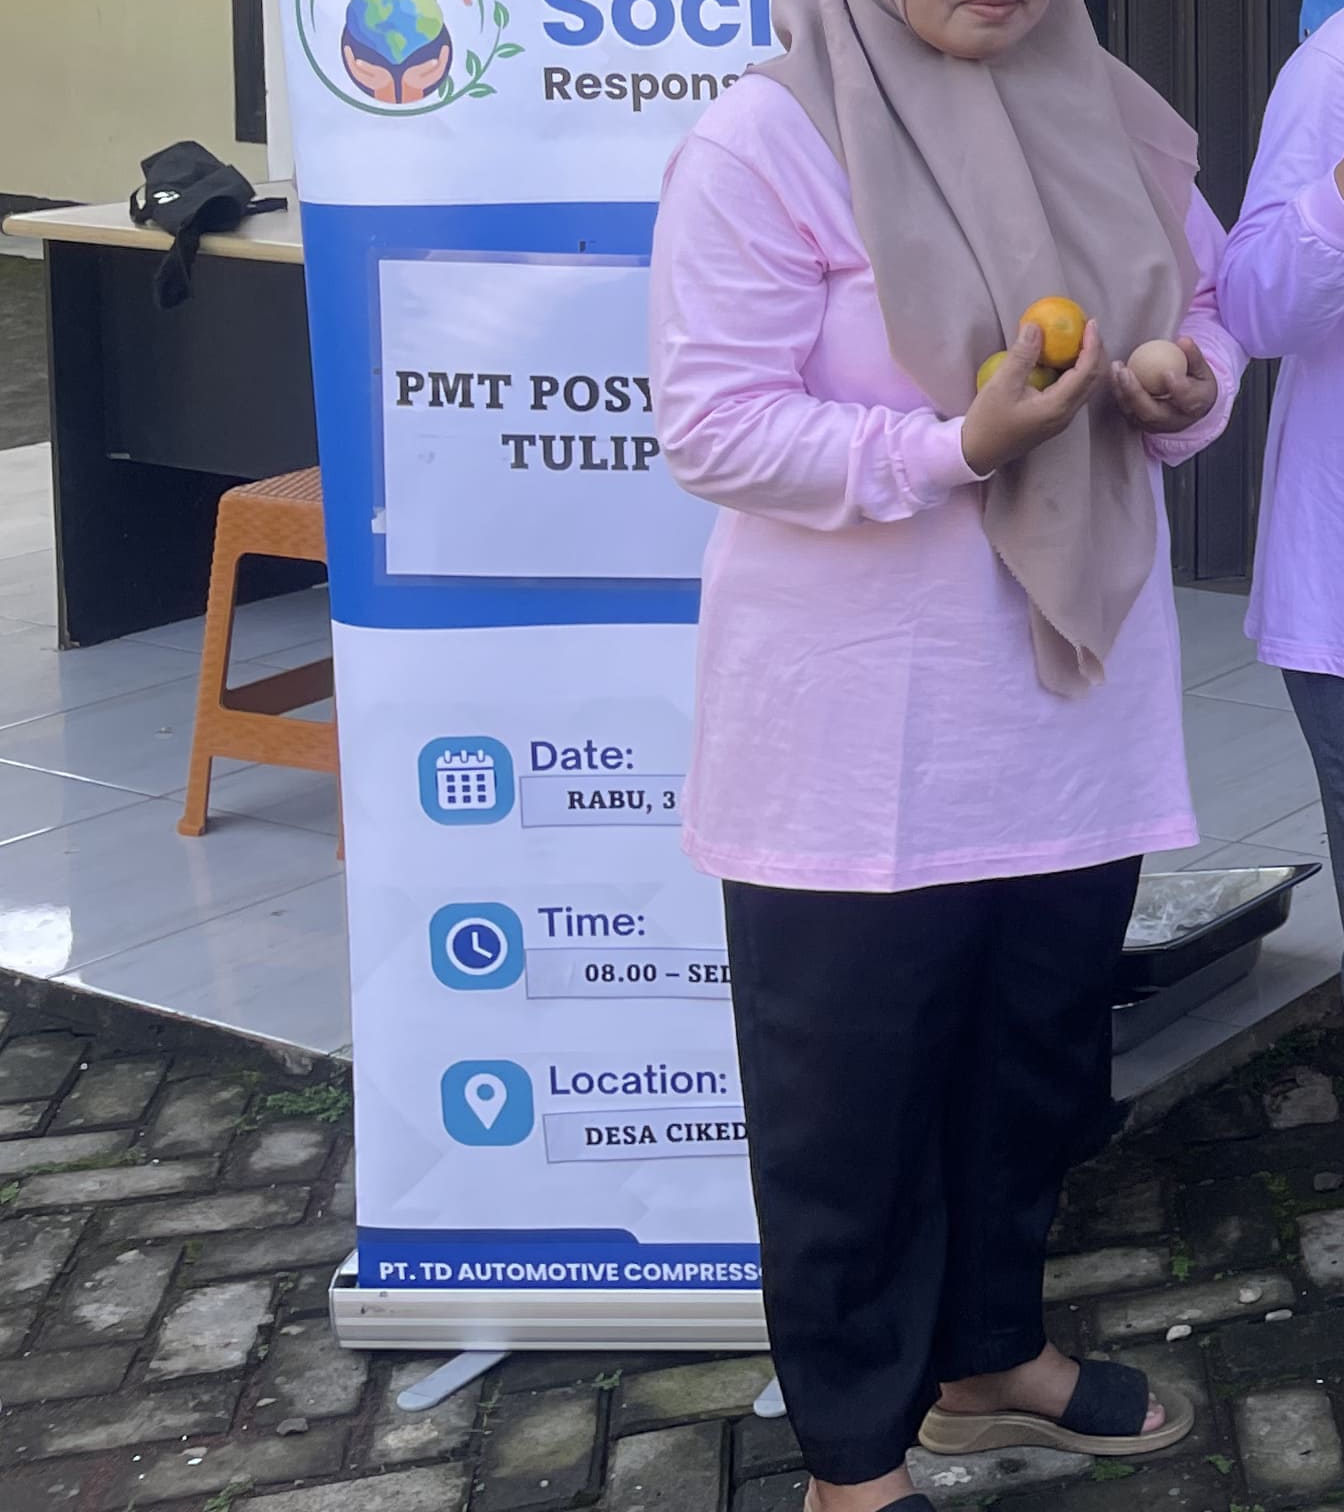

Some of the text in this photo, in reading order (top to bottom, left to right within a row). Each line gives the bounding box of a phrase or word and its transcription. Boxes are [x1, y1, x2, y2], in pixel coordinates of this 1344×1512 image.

[396, 371, 512, 409] PMT
[502, 434, 661, 471] TULIP
[531, 740, 634, 771] Date:
[567, 791, 652, 815] RABU,
[538, 906, 645, 937] Time:
[585, 964, 657, 983] 08.00
[550, 1064, 727, 1095] Location:
[585, 1122, 749, 1146] DESA CIKED
[380, 1262, 762, 1281] PT. TD AUTOMOTIVE COMPRESS
